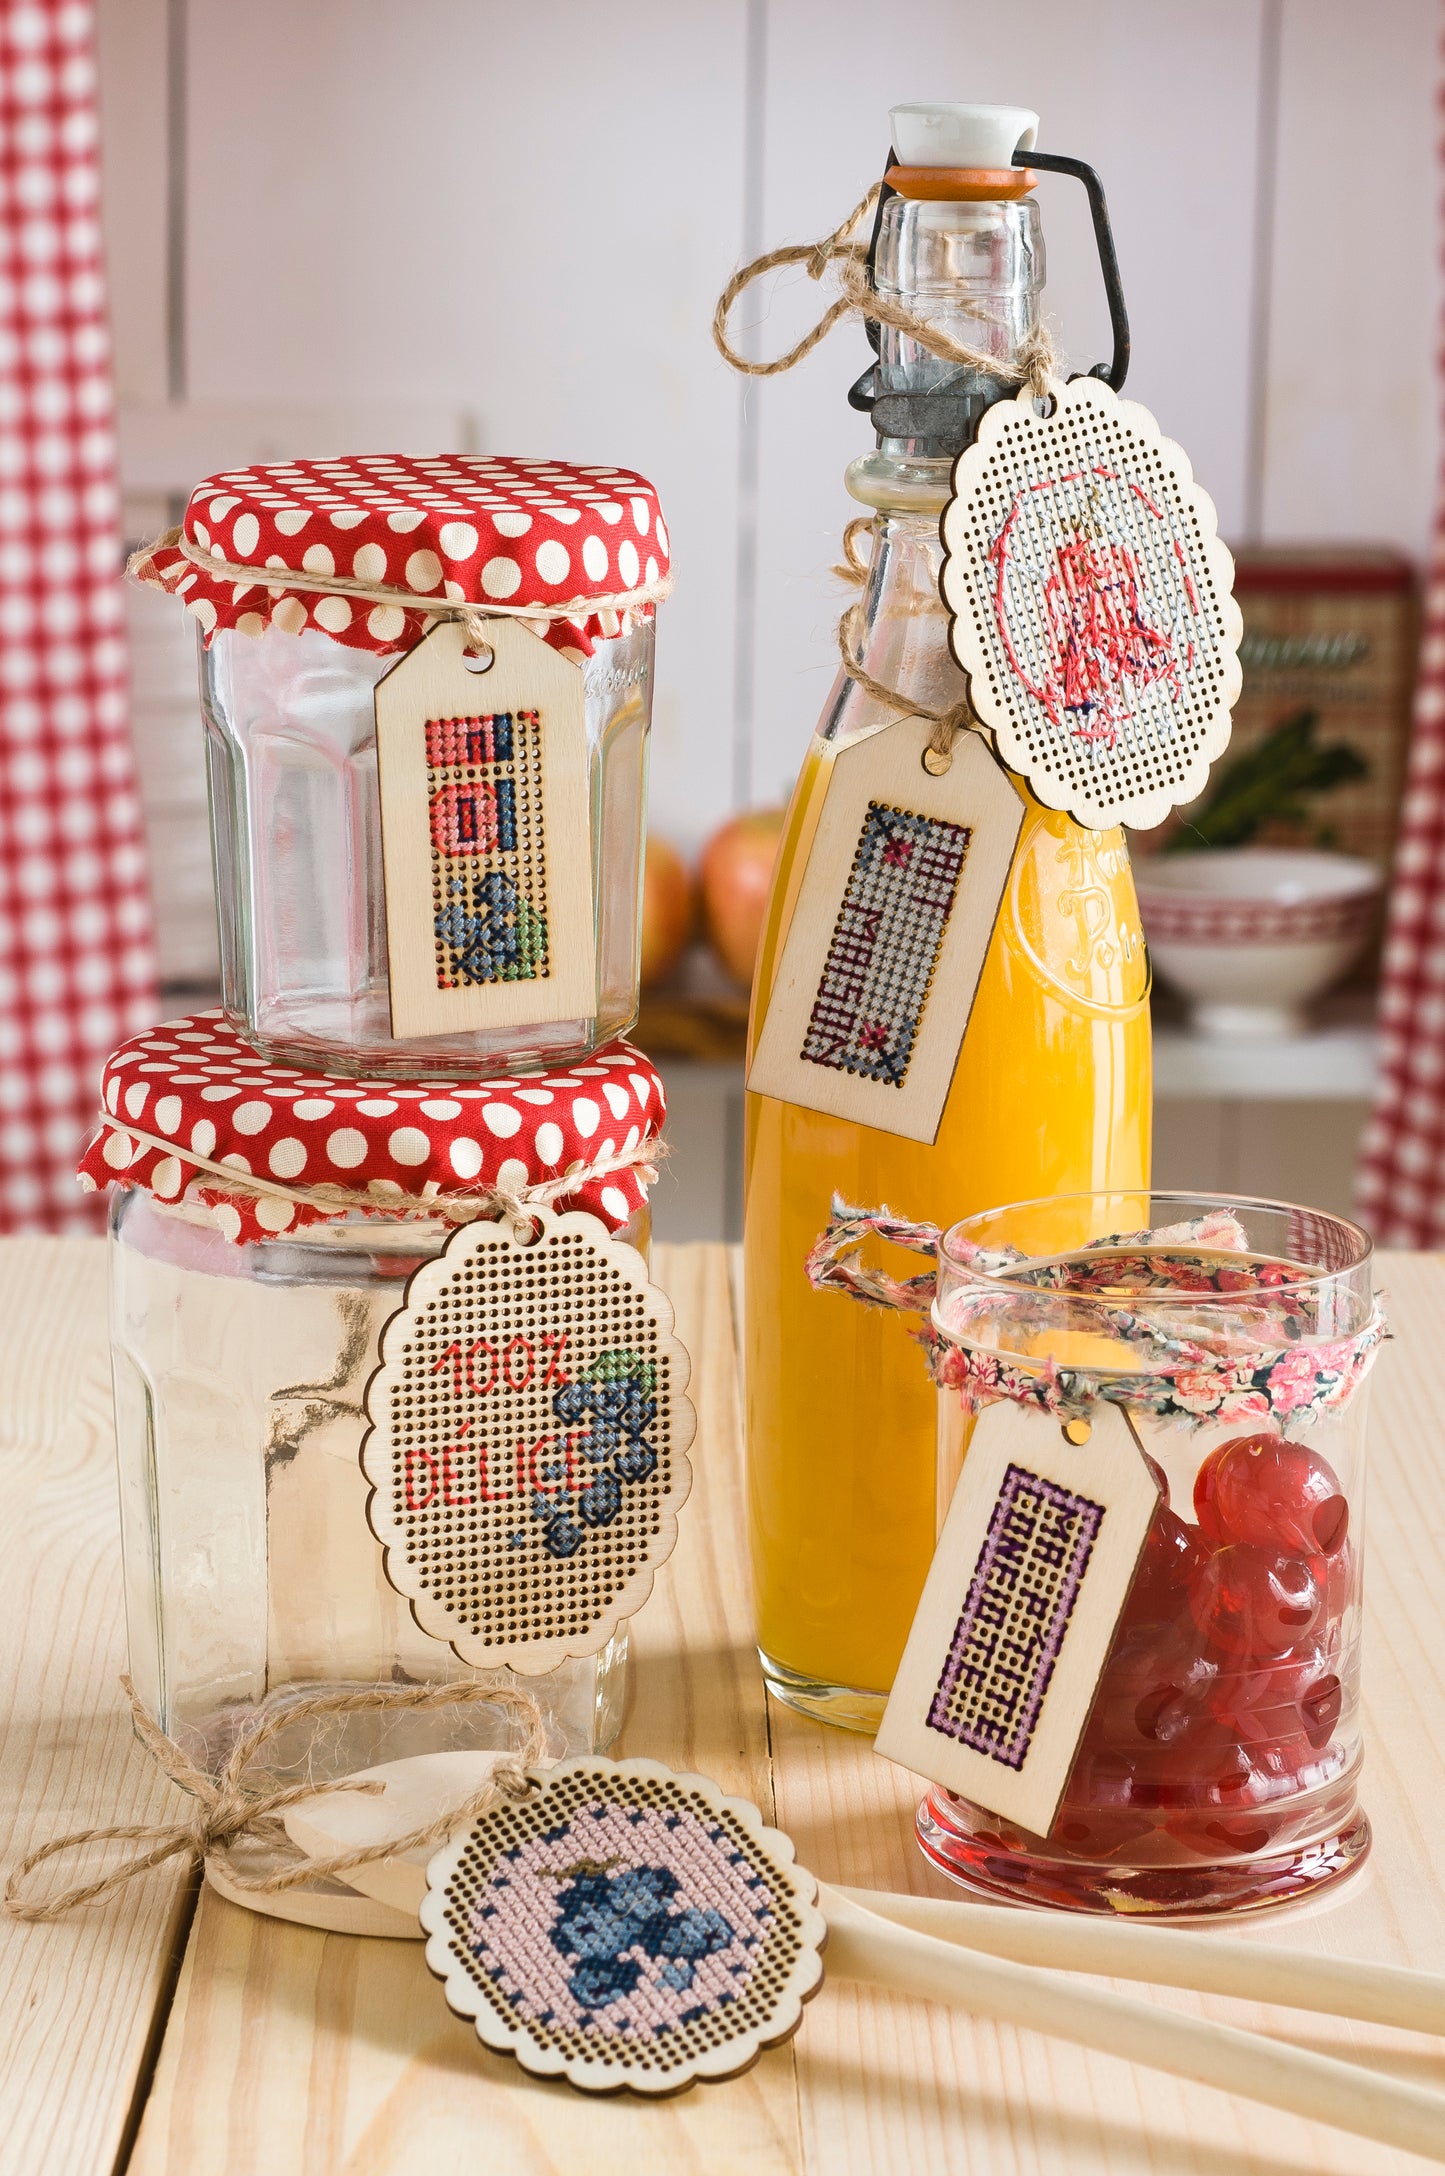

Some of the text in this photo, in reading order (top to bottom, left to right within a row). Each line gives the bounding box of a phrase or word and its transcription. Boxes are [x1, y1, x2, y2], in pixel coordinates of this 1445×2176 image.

[912, 818, 972, 922] FAIT
[800, 899, 884, 1070] MAISON
[431, 1333, 569, 1396] 100%
[404, 1420, 593, 1511] DÉLICE
[1031, 1499, 1080, 1569] MA
